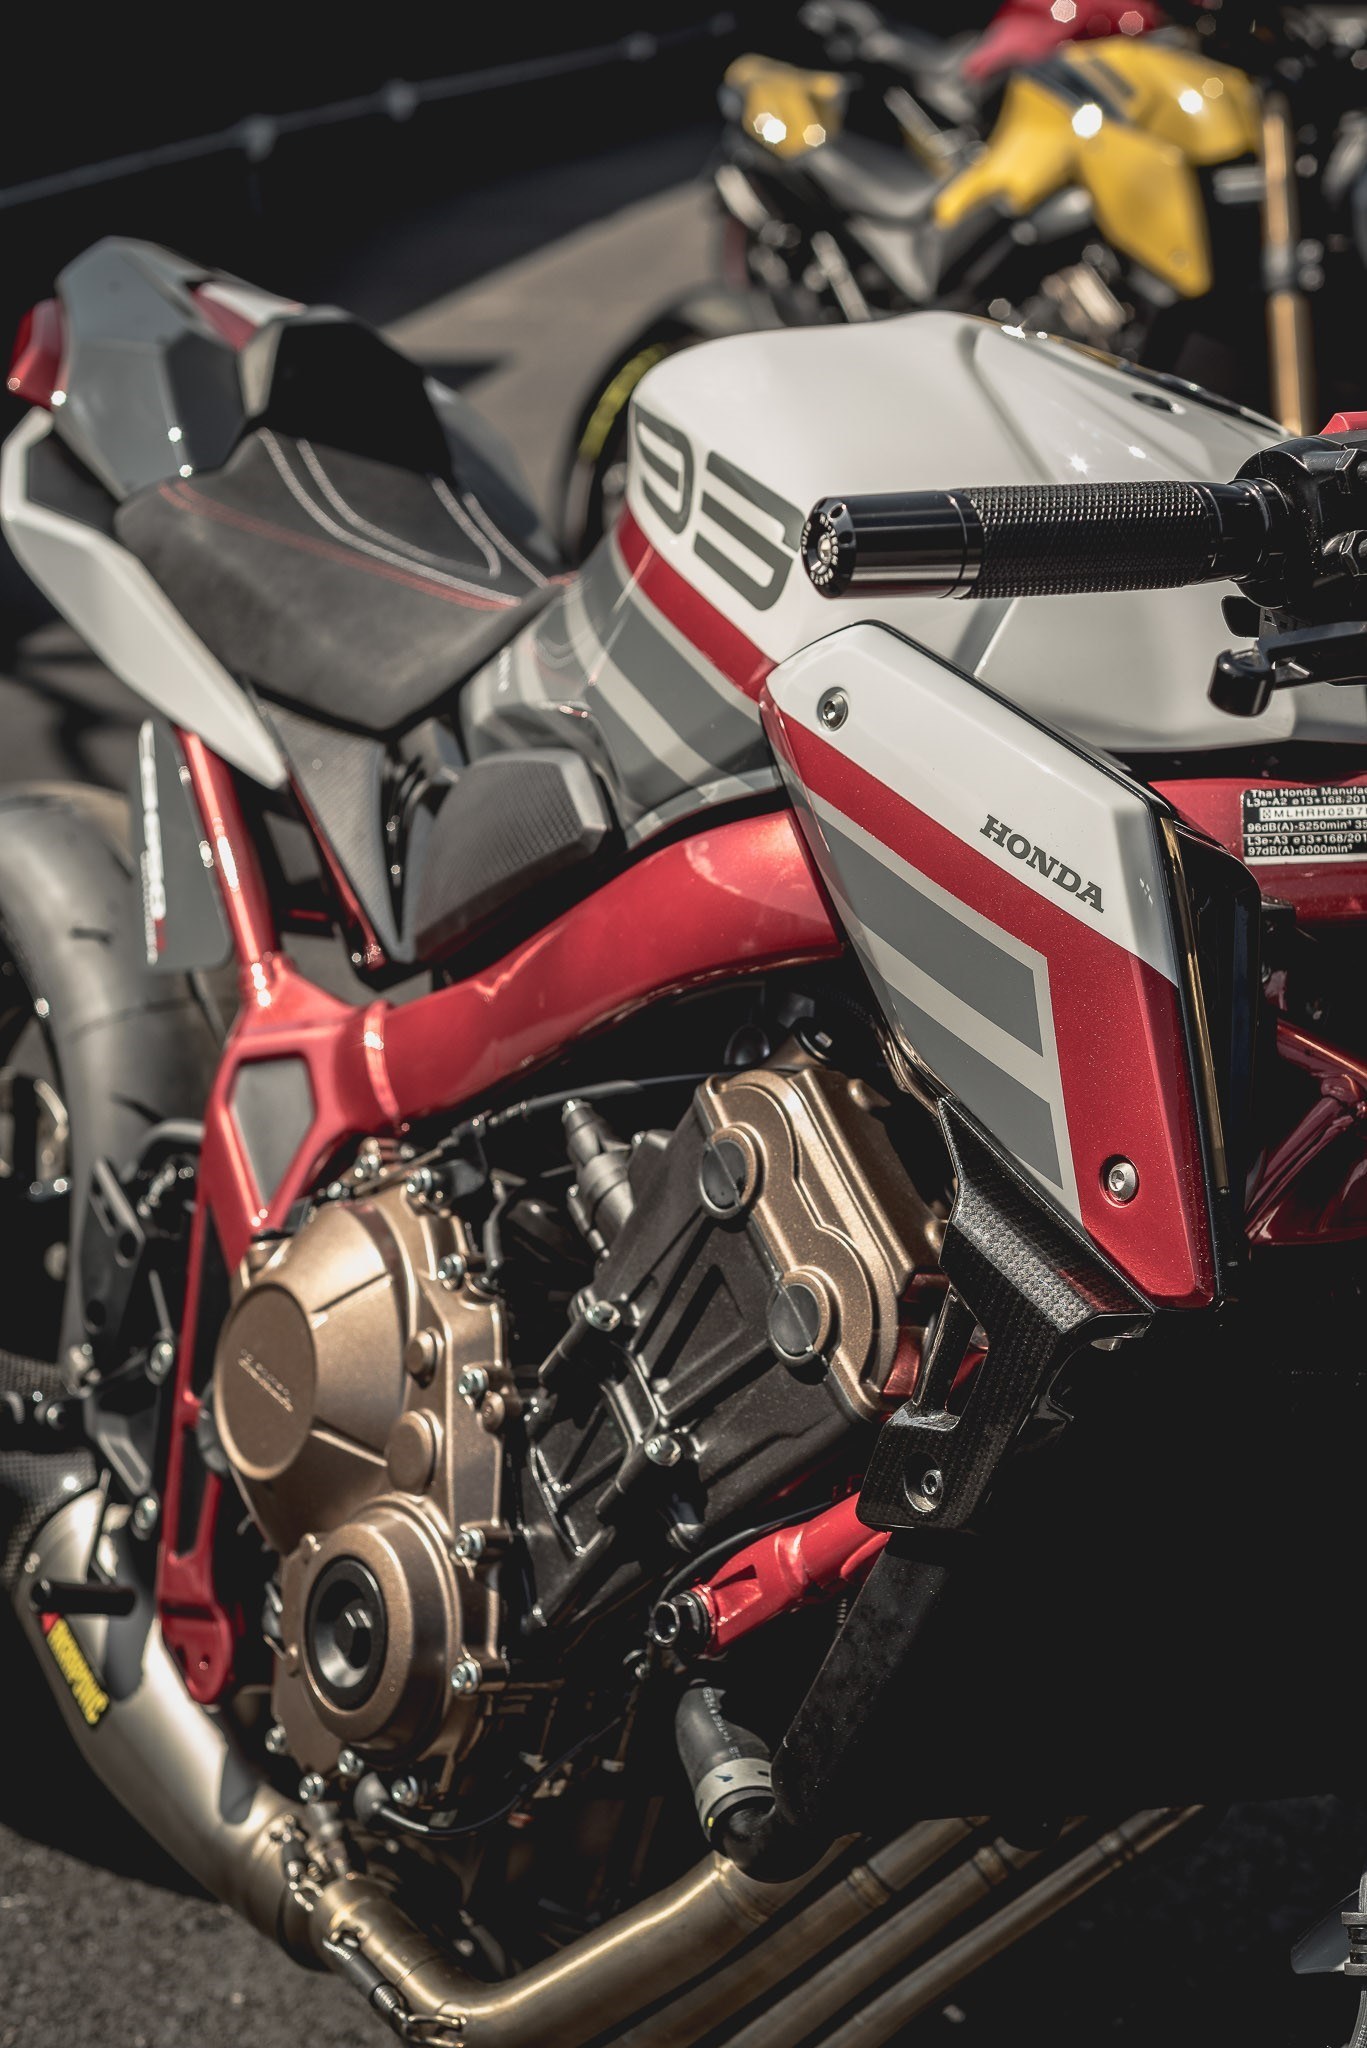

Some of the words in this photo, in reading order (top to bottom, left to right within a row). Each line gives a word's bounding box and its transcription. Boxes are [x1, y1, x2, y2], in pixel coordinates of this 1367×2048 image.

[634, 402, 806, 611] 93
[1250, 789, 1276, 798] Thai
[1280, 788, 1317, 797] Honda
[979, 814, 1104, 913] HONDA
